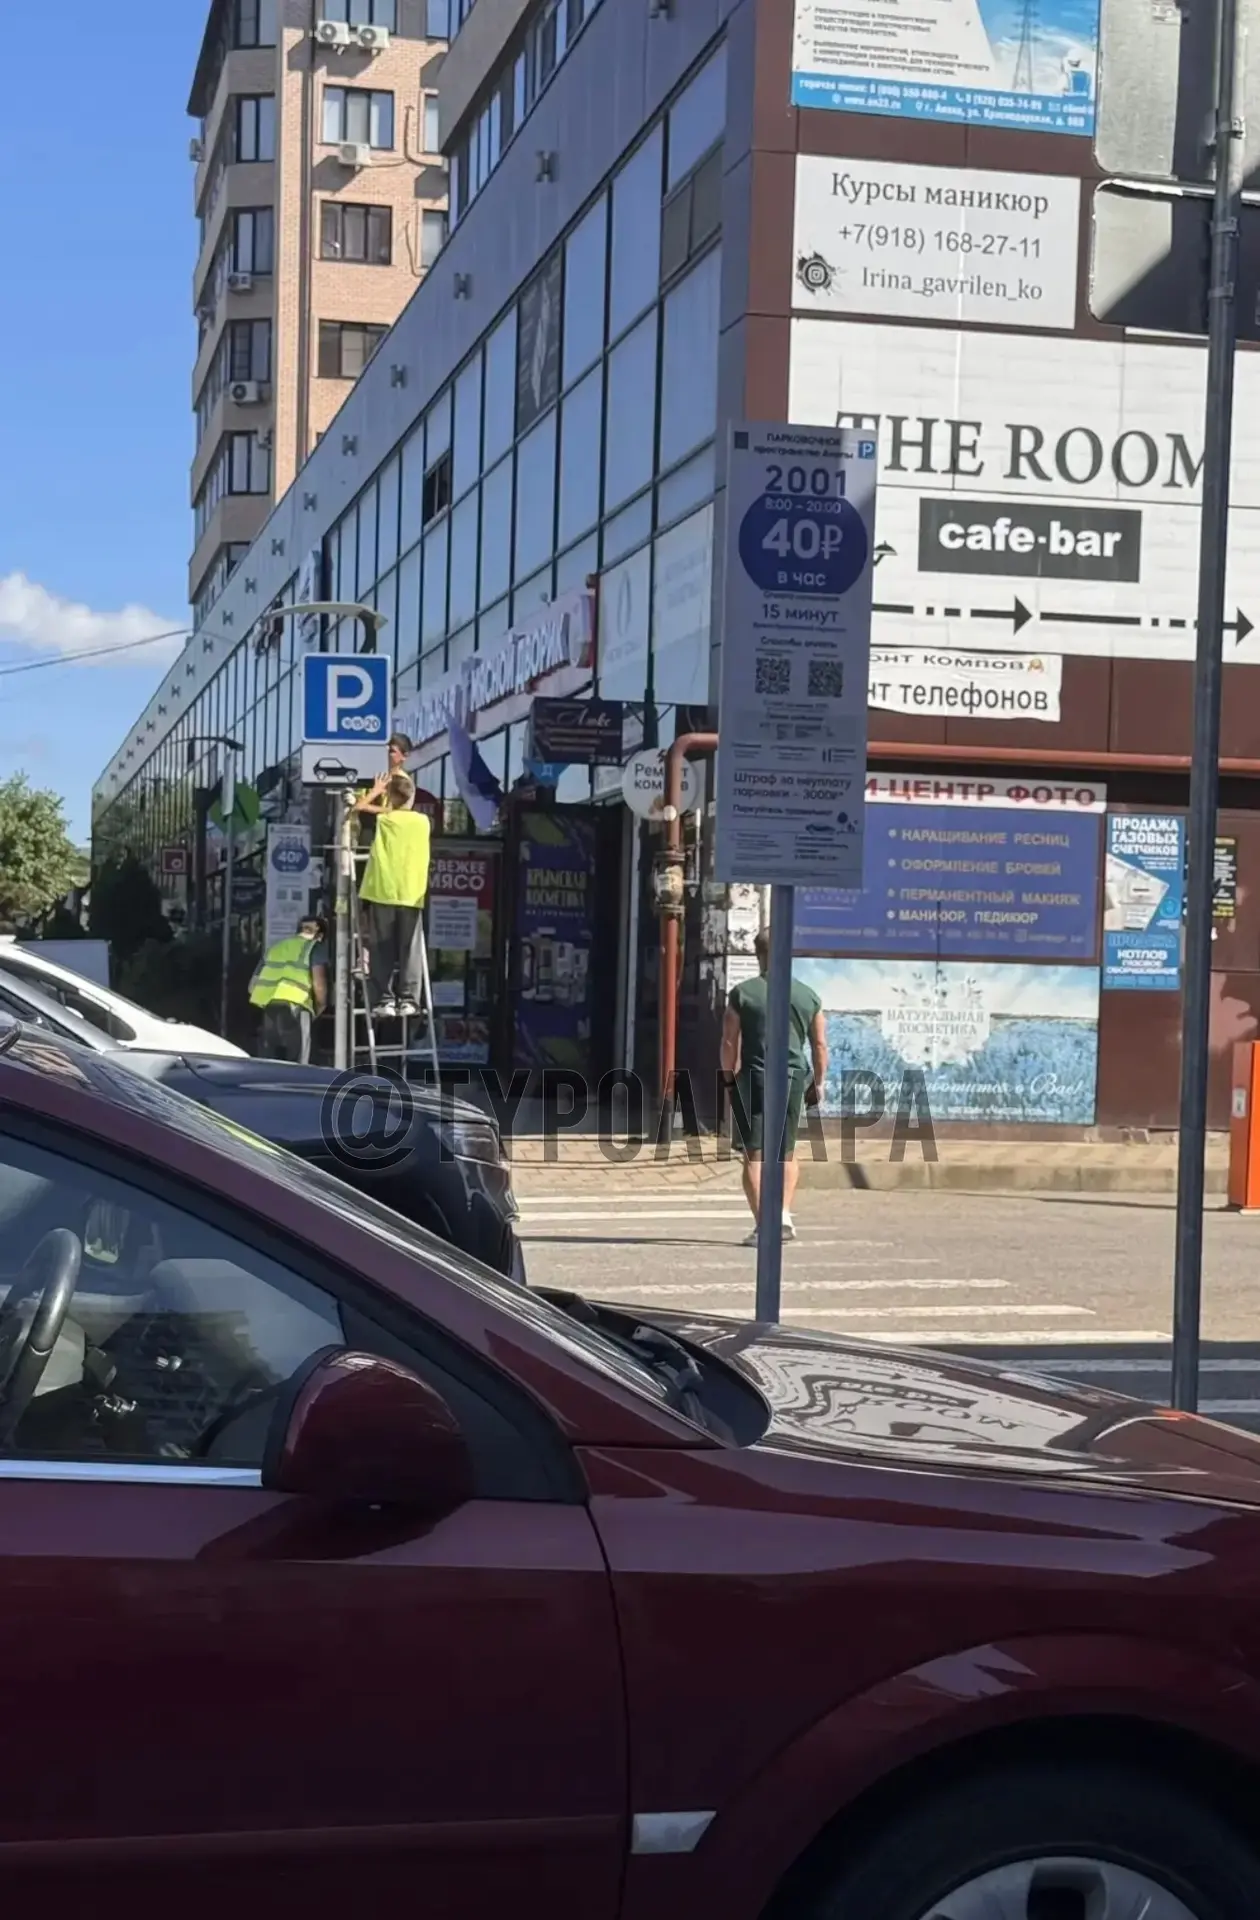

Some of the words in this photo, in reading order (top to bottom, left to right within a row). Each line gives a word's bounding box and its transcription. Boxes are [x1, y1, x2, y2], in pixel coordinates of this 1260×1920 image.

[831, 171, 916, 205] Курсы
[924, 186, 1049, 219] маникюр
[838, 223, 925, 254] +7(918)
[934, 230, 1041, 258] 168-27-11
[862, 266, 1043, 301] Irina_gavrilen_ko
[765, 464, 846, 496] 2001
[793, 572, 827, 586] час
[762, 603, 780, 619] 15
[785, 609, 839, 625] минут
[327, 664, 374, 733] P
[900, 681, 1048, 714] телефонов
[634, 763, 689, 777] Ремт
[634, 779, 689, 791] комв
[734, 772, 777, 786] Штраф
[797, 778, 852, 790] неуплату
[733, 787, 790, 800] парковки
[1005, 784, 1096, 806] ФОТО
[1112, 817, 1179, 832] ПРОДАЖА
[901, 829, 1007, 845] НАРАЩИВАНИЕ
[1013, 832, 1070, 848] РЕСНИЦ
[1111, 831, 1179, 845] ГАЗОВЫХ
[1111, 843, 1179, 856] СЧЕТЧИКОВ
[901, 859, 998, 874] ОФОРМЛЕНИЕ
[1005, 860, 1061, 877] БРОВЕЙ
[900, 887, 1014, 904] ПЕРМАНЕНТНЫЙ
[887, 1008, 985, 1024] НАТУРАЛЬНАЯ
[898, 1022, 978, 1036] КОСМЕТИКА
